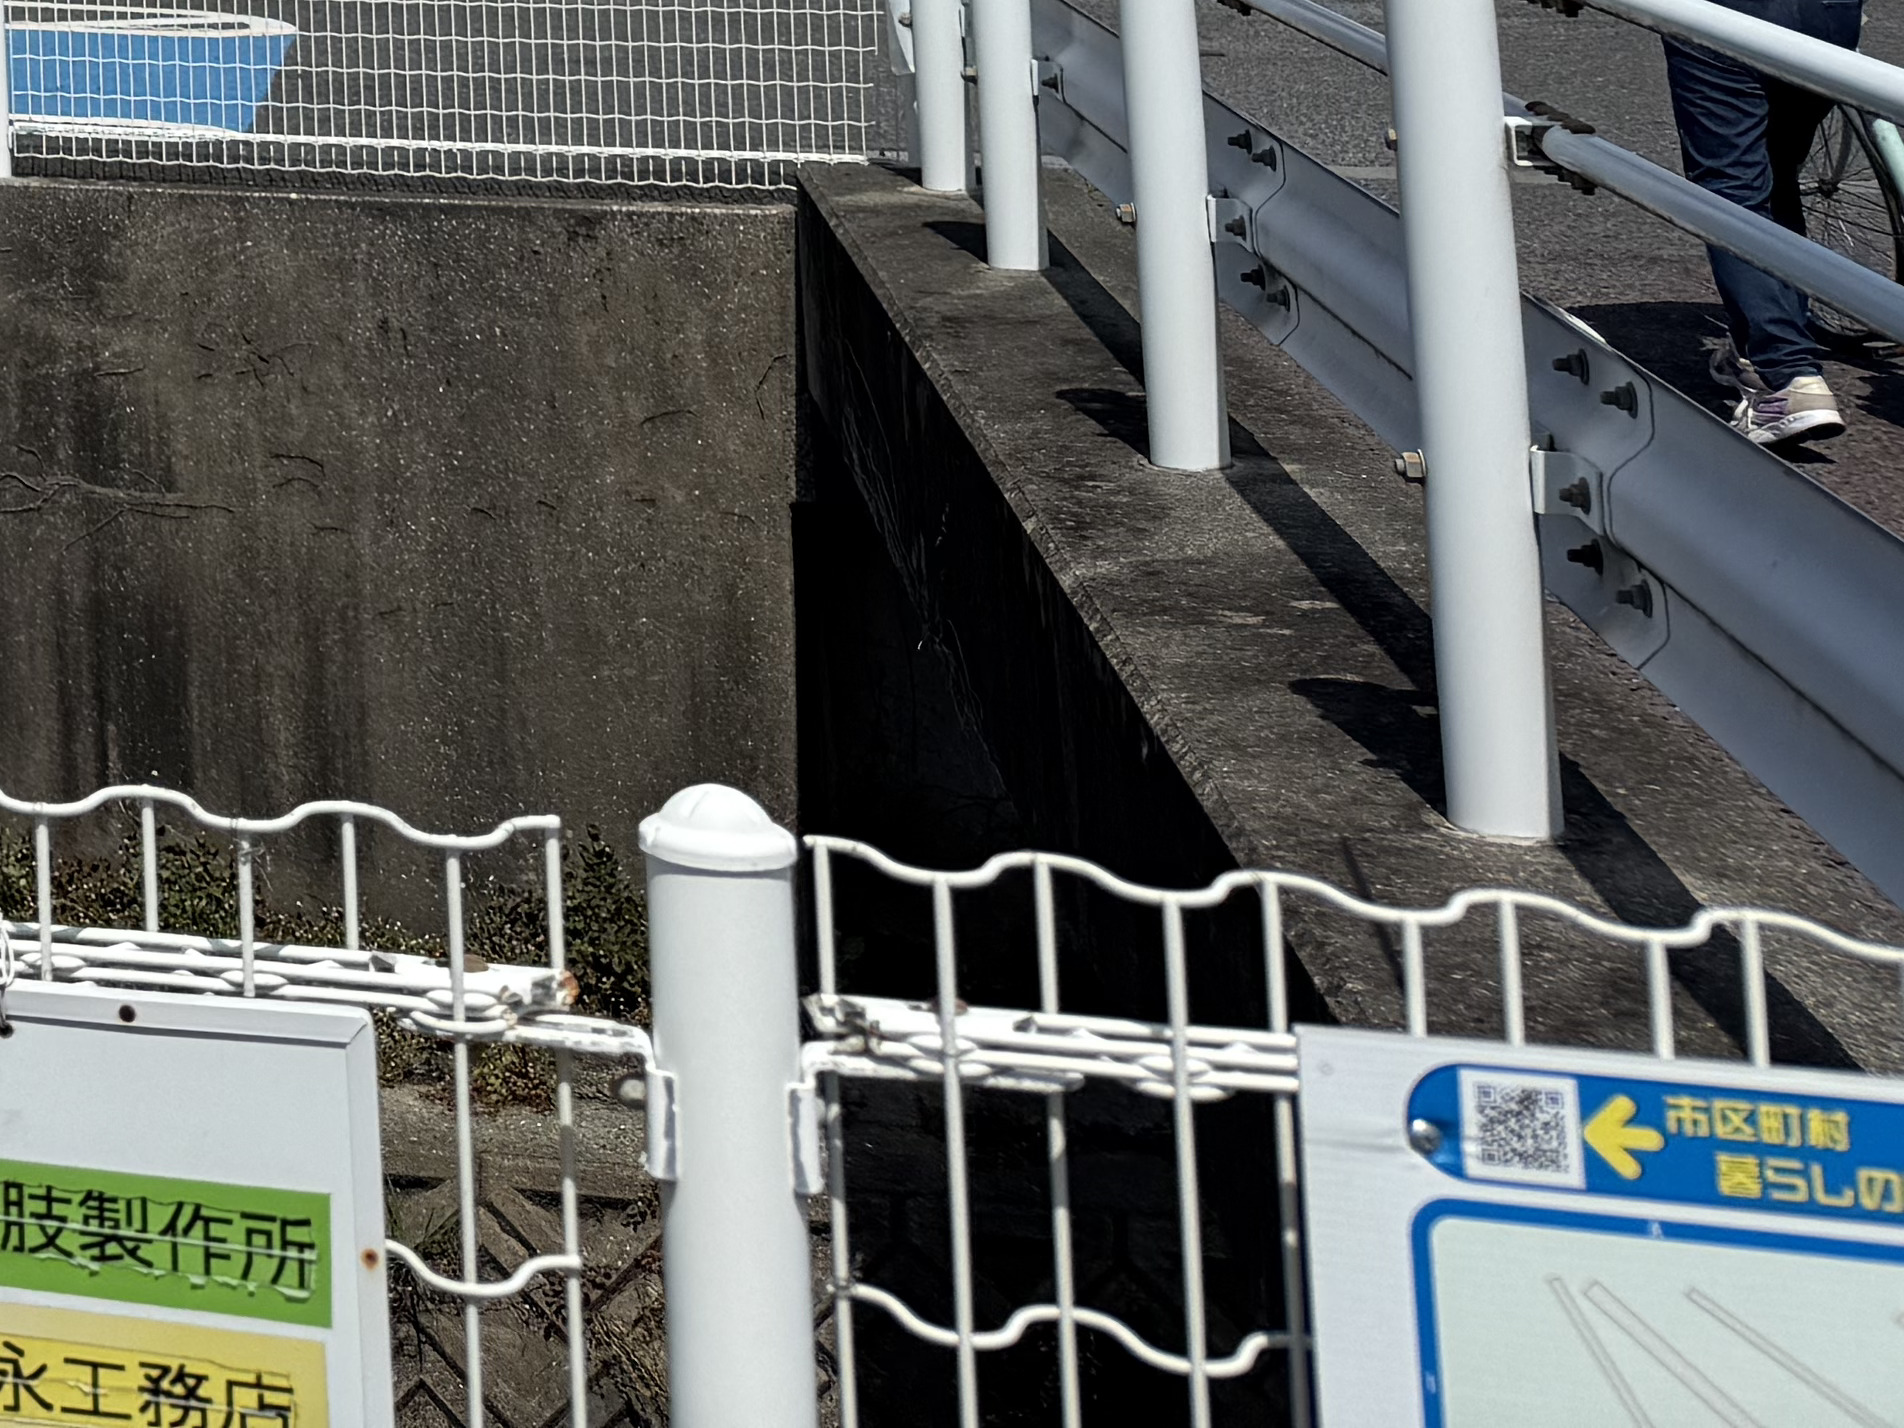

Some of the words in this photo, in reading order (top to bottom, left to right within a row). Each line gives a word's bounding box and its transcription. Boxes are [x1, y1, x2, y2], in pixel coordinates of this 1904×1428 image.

[1664, 1096, 1851, 1153] 市区町村
[1715, 1152, 1904, 1214] 暮らしの
